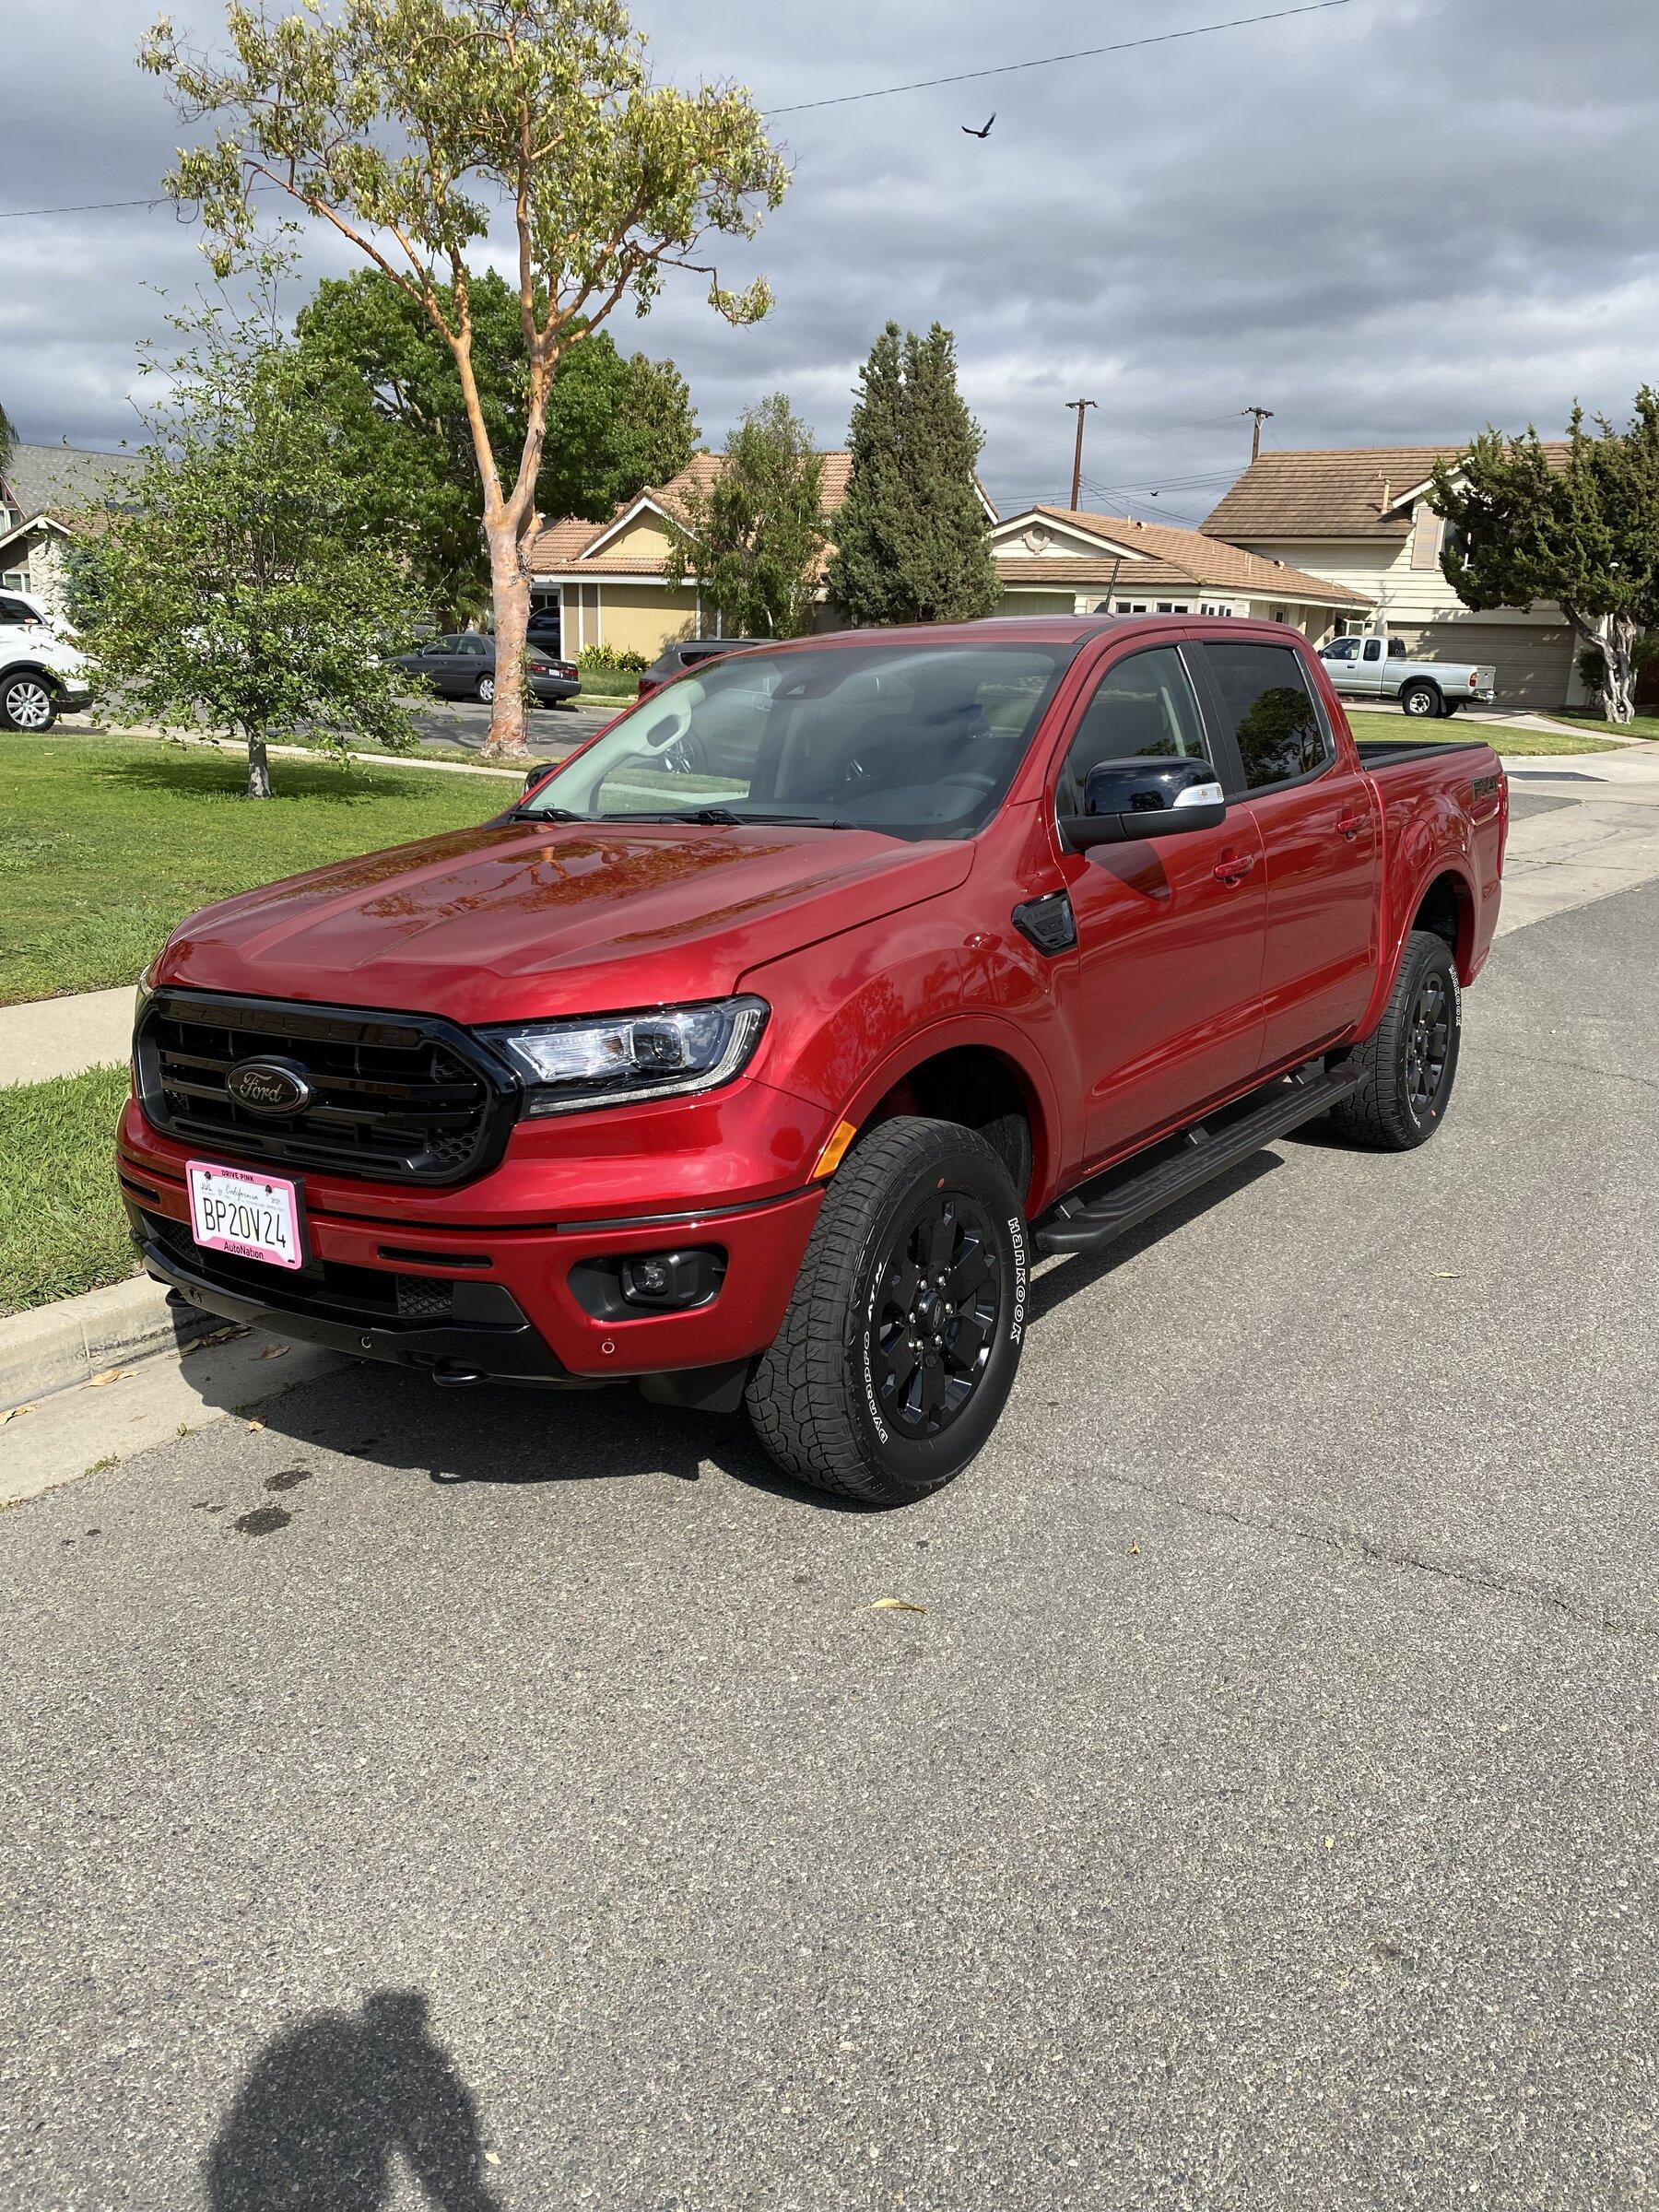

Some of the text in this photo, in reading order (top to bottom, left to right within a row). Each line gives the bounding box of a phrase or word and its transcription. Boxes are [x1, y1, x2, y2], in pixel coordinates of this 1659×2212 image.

[1473, 775, 1496, 801] FX4
[240, 1072, 283, 1102] Ford
[221, 1170, 255, 1182] DRIVE PINK
[200, 1182, 213, 1192] JUL
[225, 1183, 259, 1202] California
[202, 1197, 287, 1248] BP20V24
[223, 1241, 265, 1260] AutoNation
